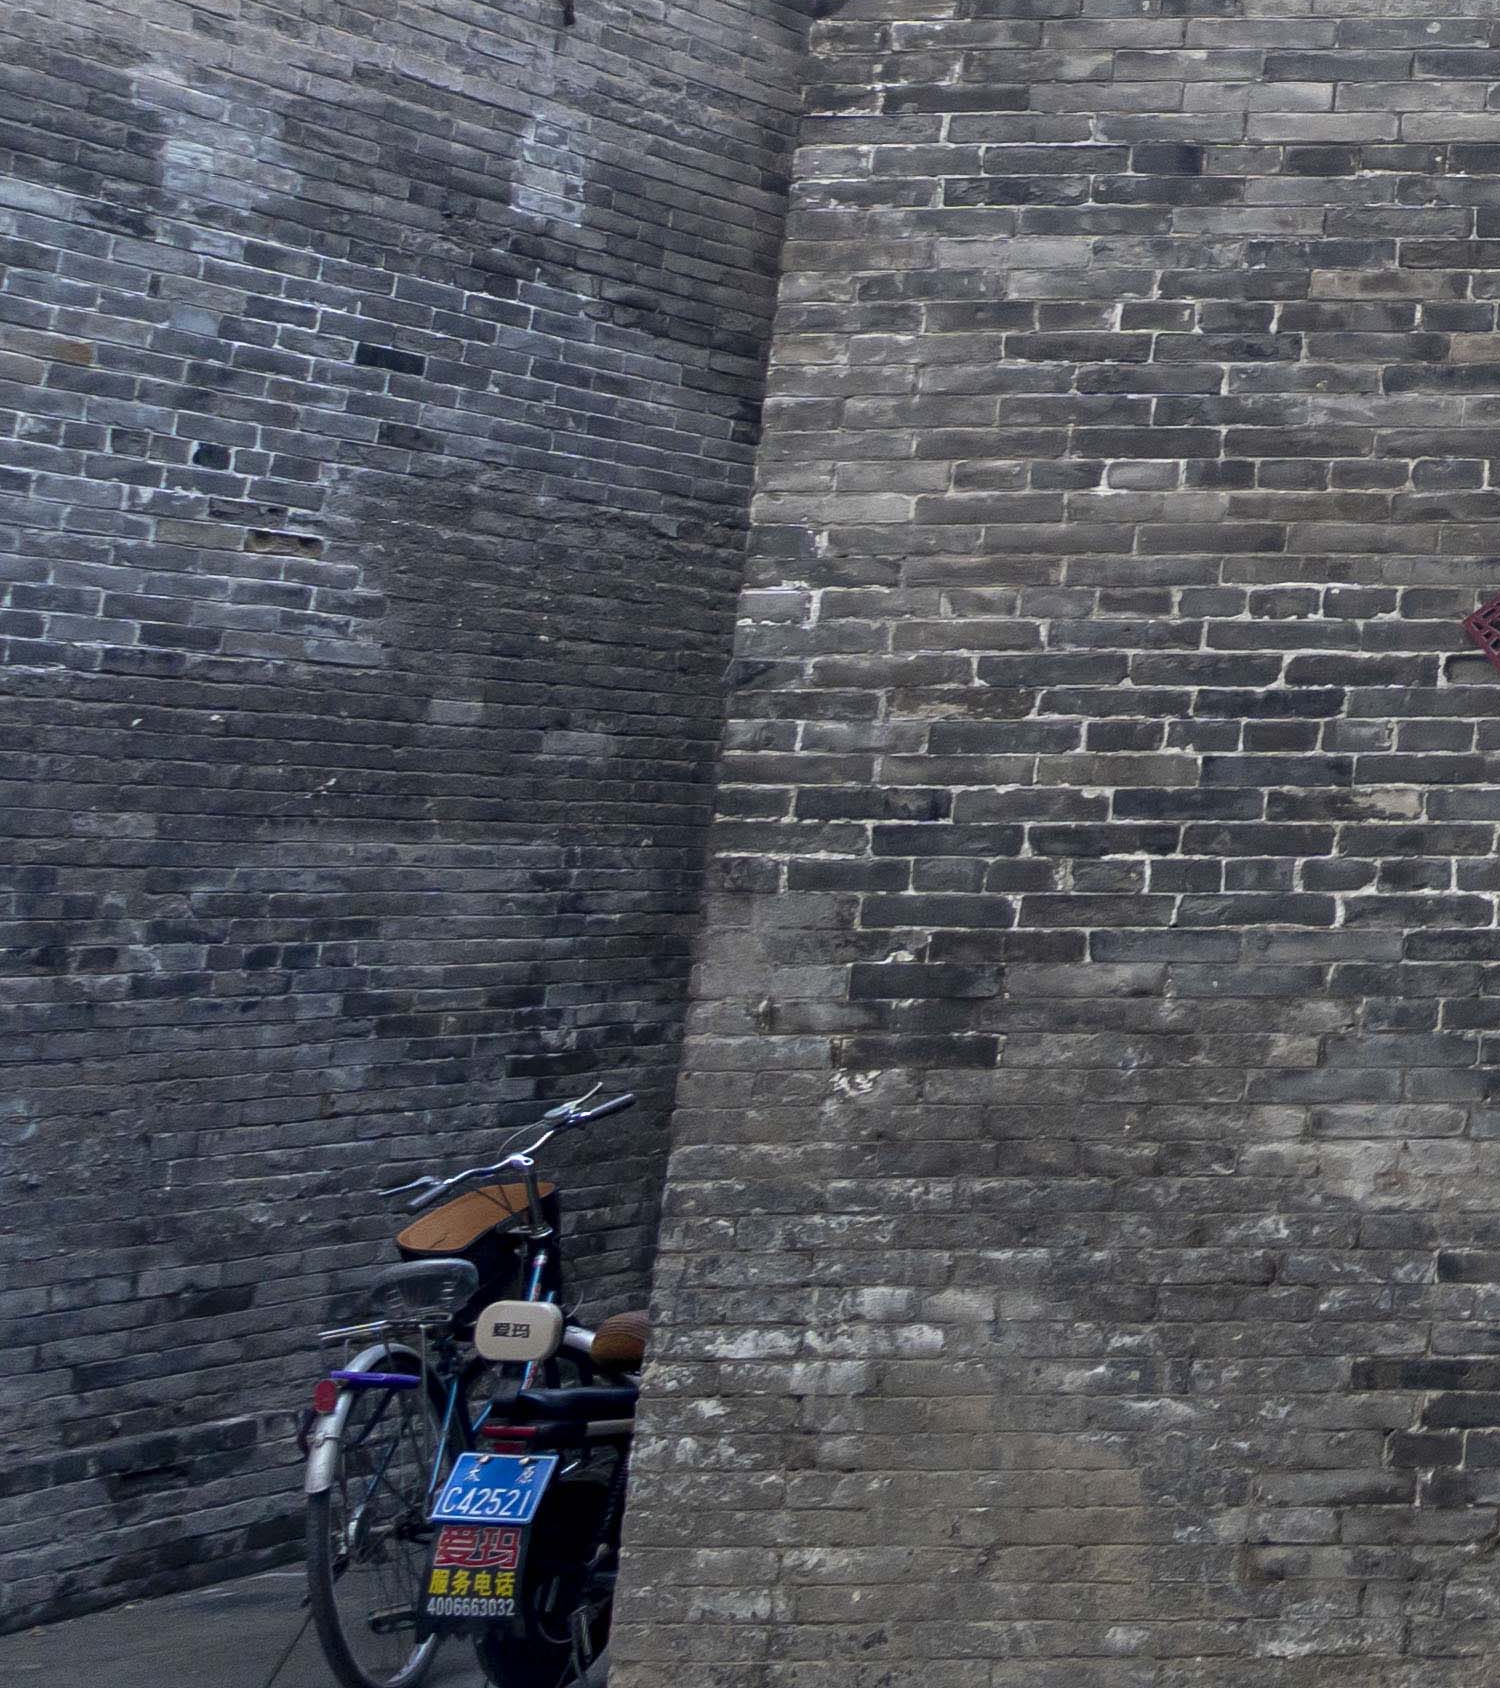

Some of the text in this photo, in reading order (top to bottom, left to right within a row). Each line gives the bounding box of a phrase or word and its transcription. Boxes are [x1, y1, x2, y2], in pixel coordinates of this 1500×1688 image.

[492, 1322, 530, 1339] 爱玛
[442, 1487, 527, 1516] C42521
[428, 1569, 516, 1597] 服务电话
[427, 1597, 516, 1617] 4006663032
